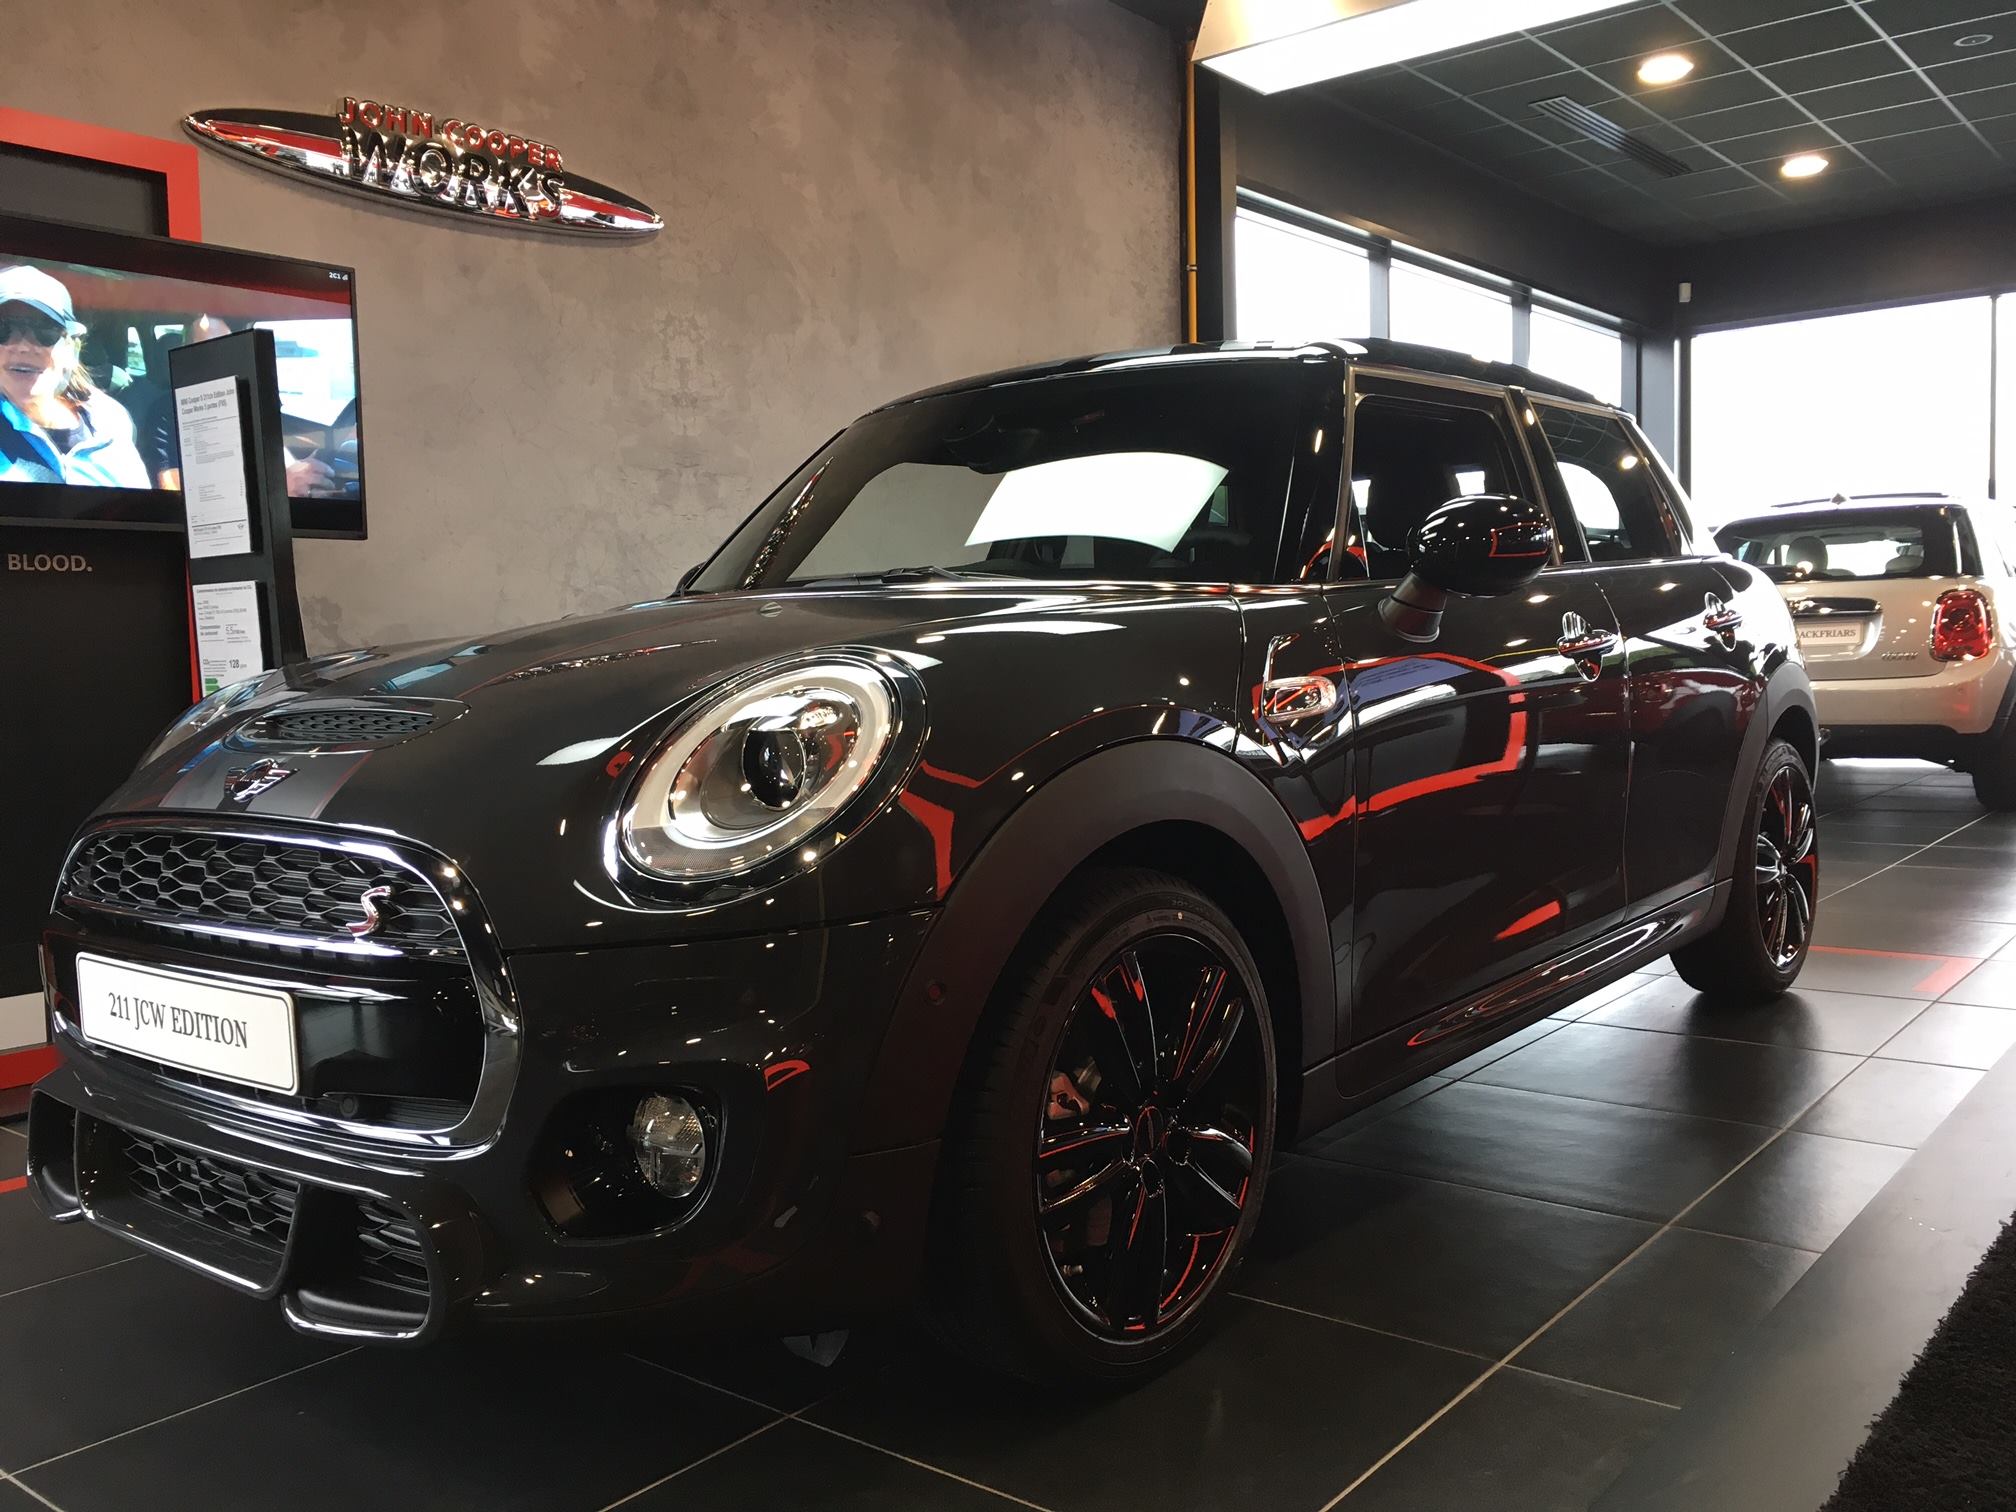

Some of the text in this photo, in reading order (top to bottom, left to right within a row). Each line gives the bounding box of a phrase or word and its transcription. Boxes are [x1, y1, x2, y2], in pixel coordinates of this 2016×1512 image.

[338, 97, 564, 172] JOHN COOPER
[340, 124, 565, 219] WORKS
[7, 553, 93, 572] BLOOD.
[1799, 629, 1857, 639] ACKFRIARS
[345, 885, 391, 938] S
[108, 992, 249, 1049] 211 JCW EDITION
